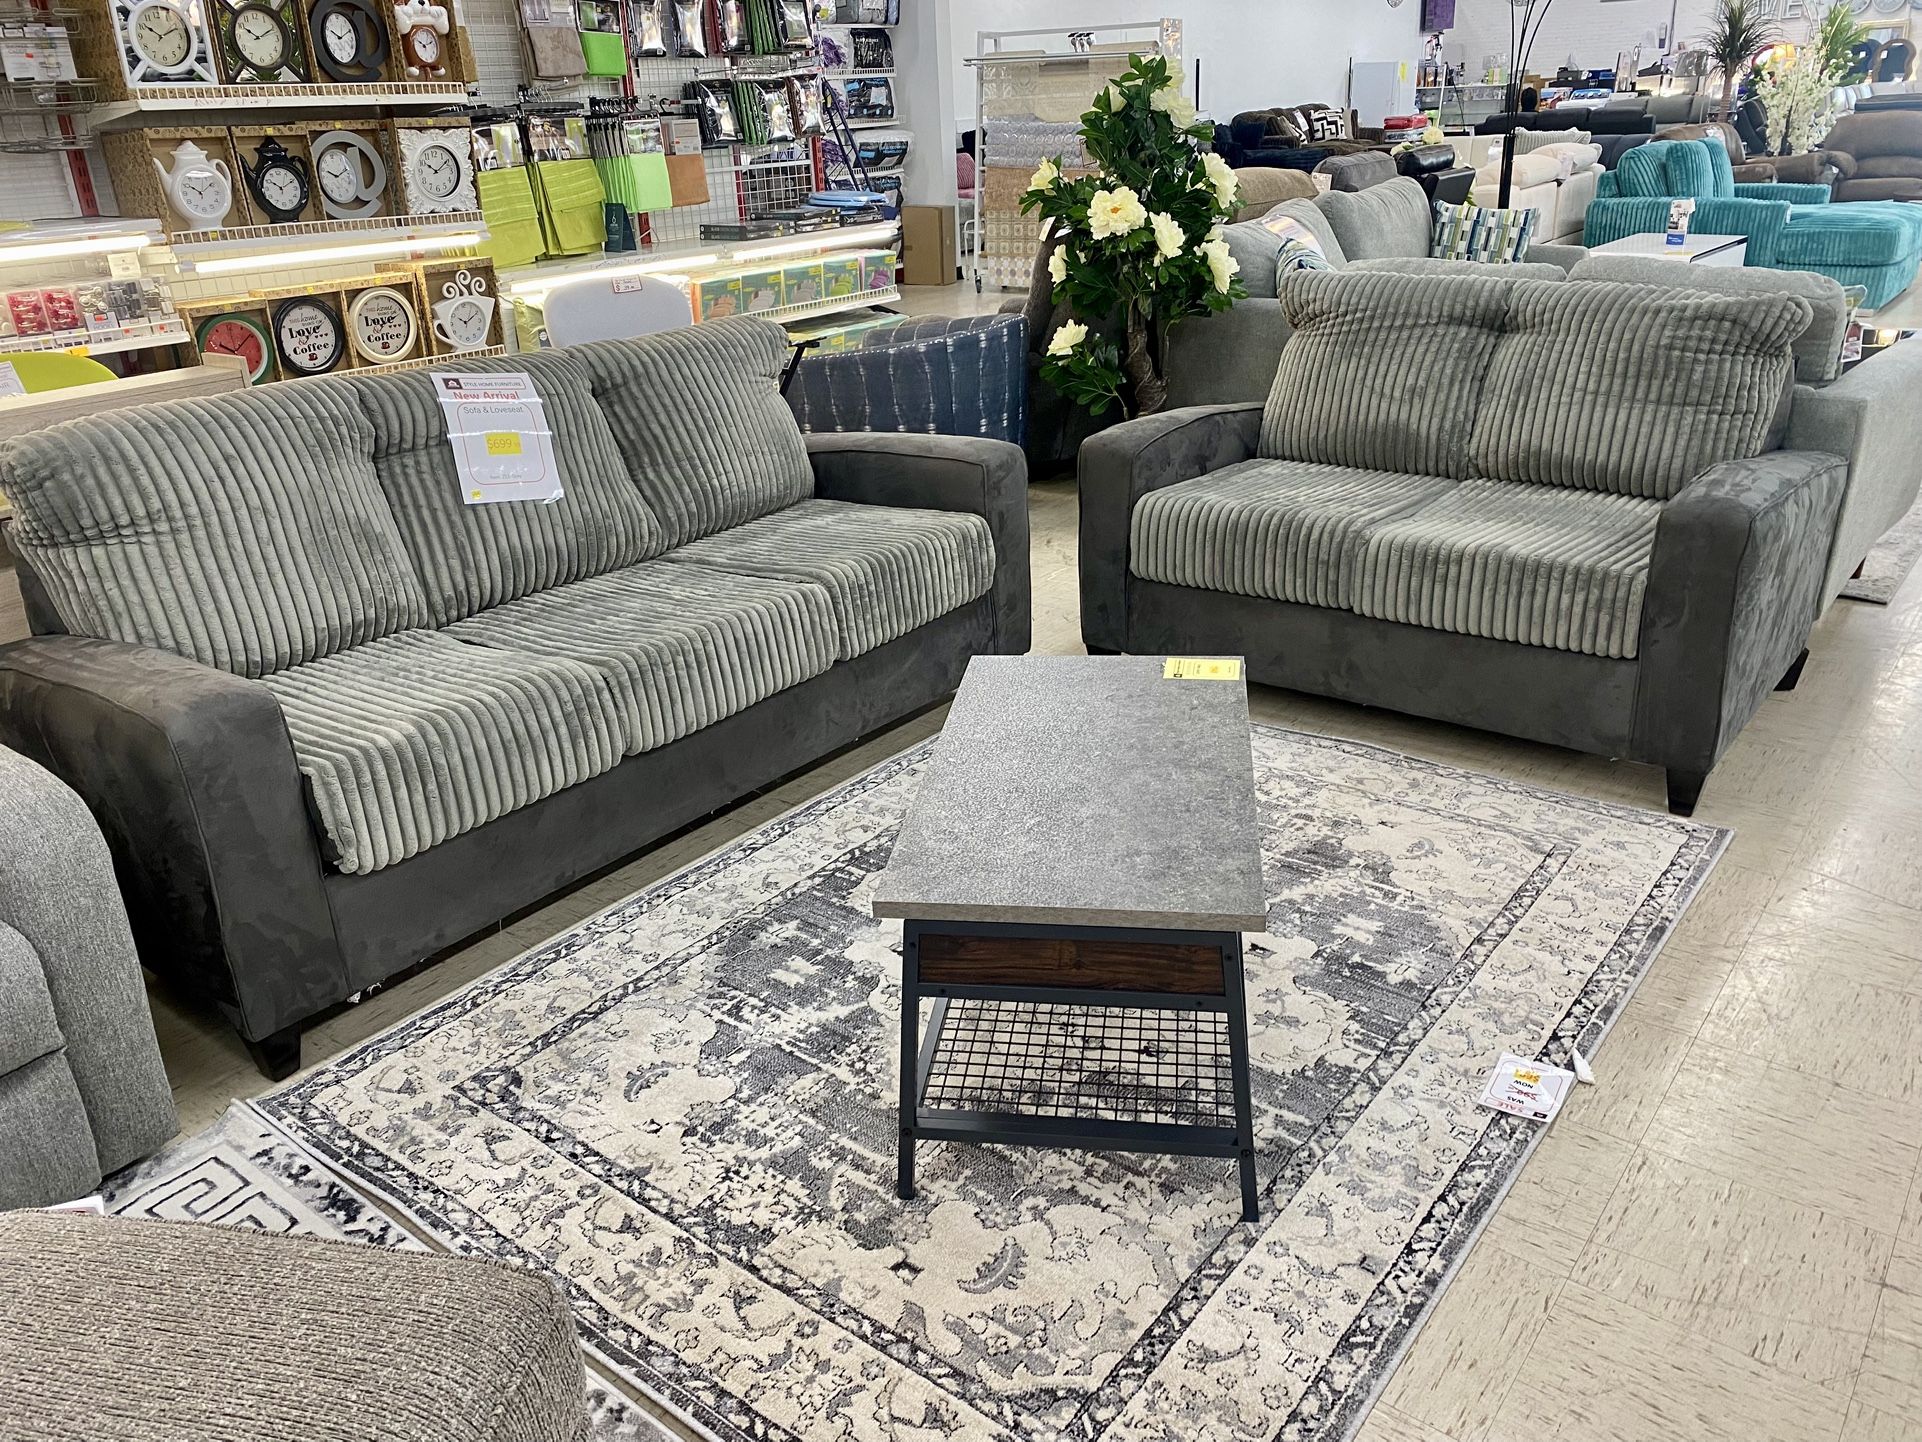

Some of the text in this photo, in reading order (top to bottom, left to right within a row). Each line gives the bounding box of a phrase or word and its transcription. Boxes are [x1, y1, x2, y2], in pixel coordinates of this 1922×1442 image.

[364, 315, 396, 327] Love
[288, 325, 323, 340] Love
[367, 332, 402, 343] Coffee
[292, 342, 330, 355] Coffee
[453, 390, 520, 400] New Arrival
[463, 406, 482, 414] Sofa
[490, 405, 524, 414] Loveseat
[1513, 1080, 1534, 1089] NOW
[1507, 1096, 1525, 1105] WAS
[1497, 1101, 1524, 1113] SALE
